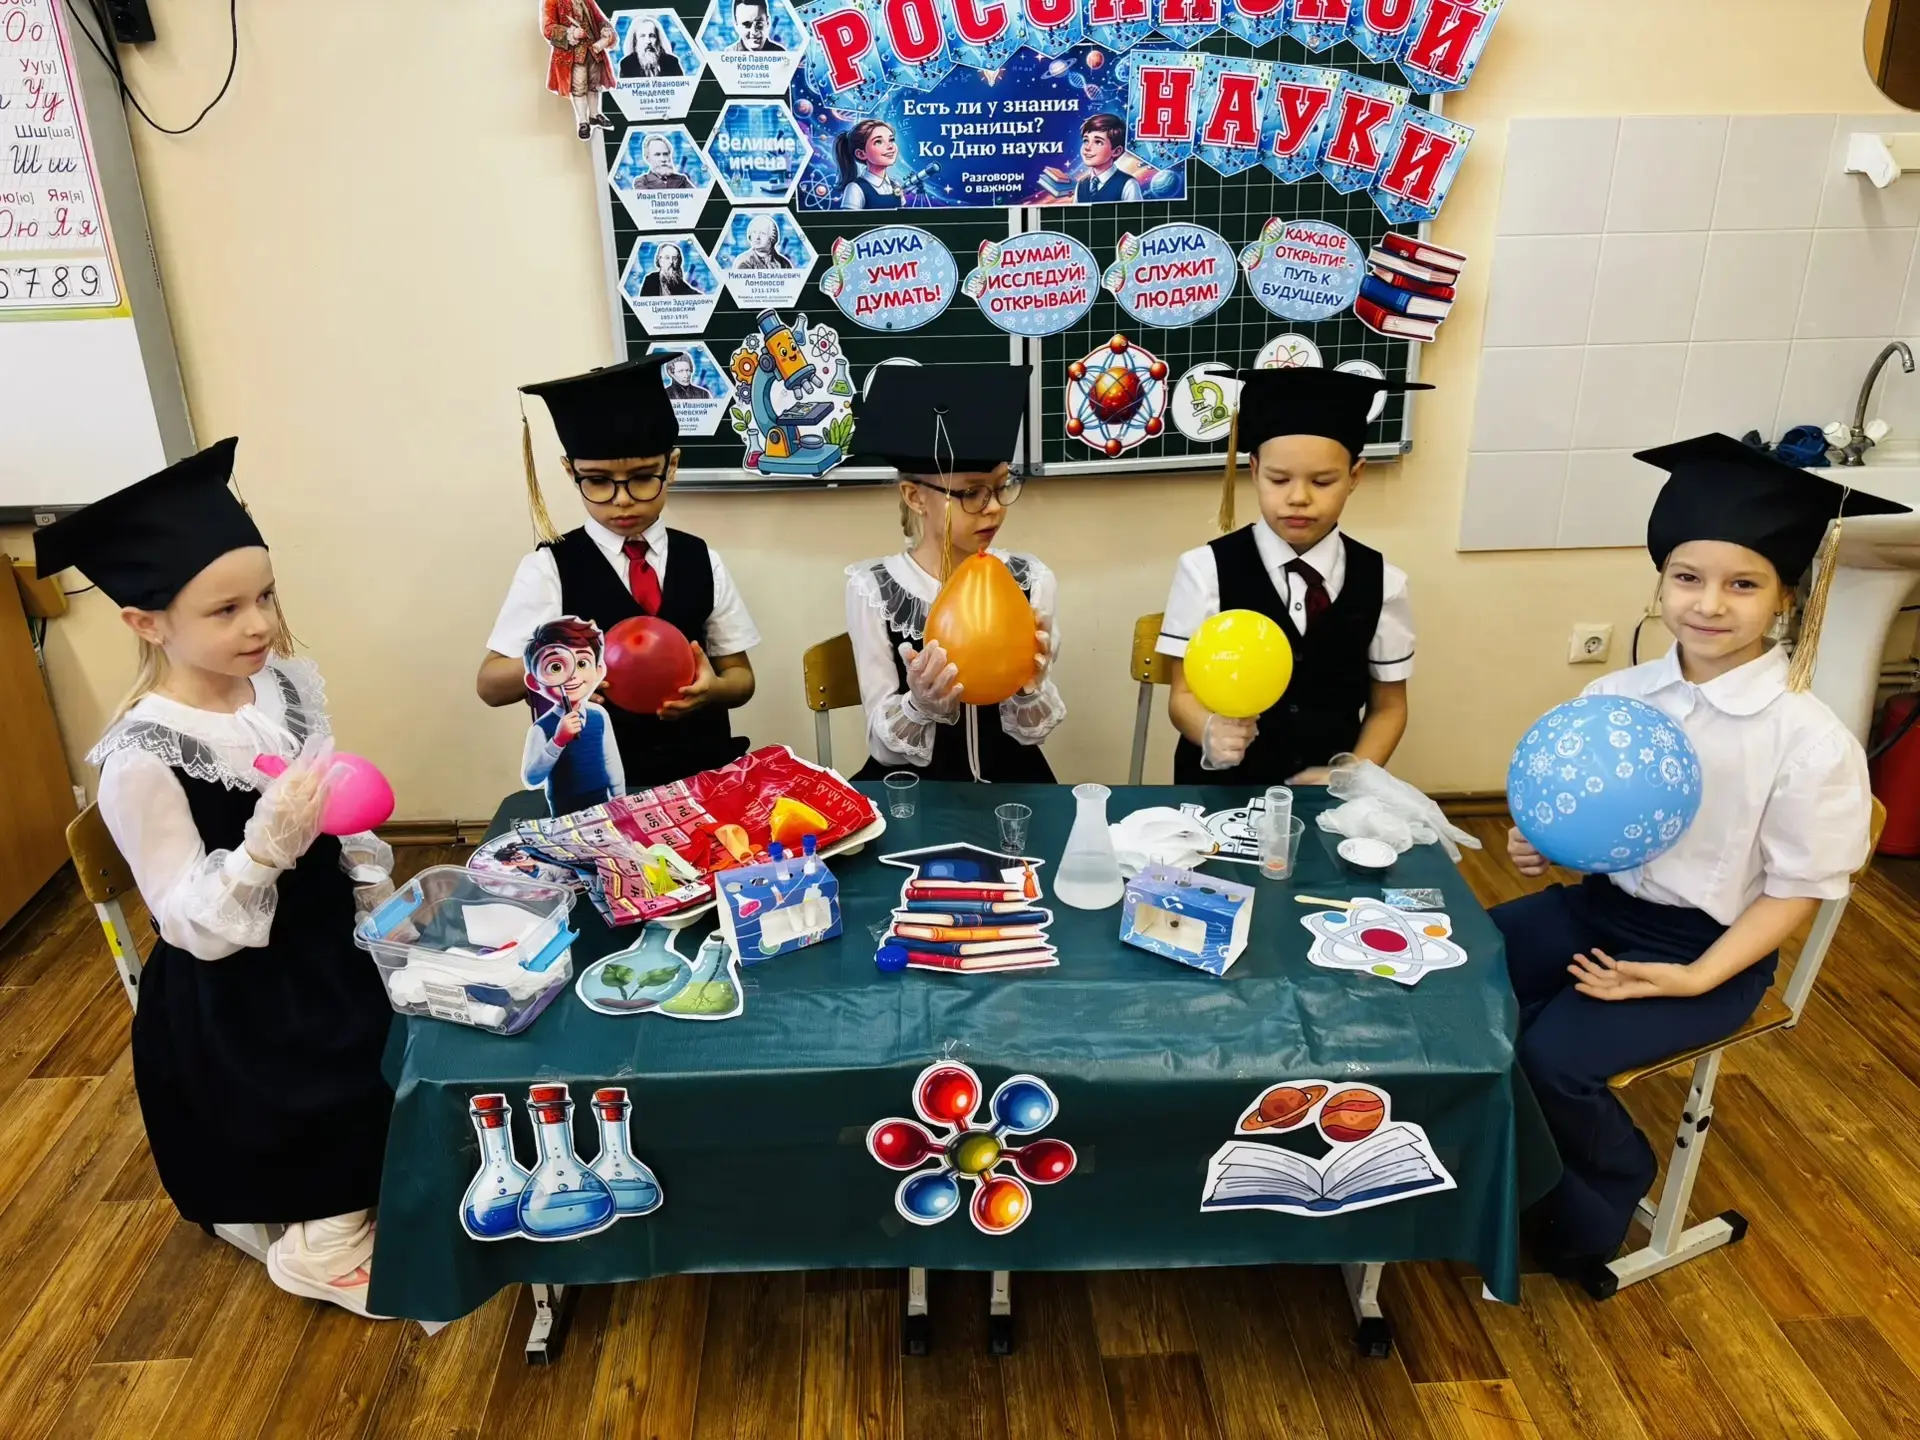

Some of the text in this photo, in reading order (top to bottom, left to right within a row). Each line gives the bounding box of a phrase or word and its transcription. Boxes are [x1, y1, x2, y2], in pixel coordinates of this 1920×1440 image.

[721, 54, 787, 63] Сергей Павлович
[616, 79, 690, 91] Дмитрий Иванович
[632, 88, 675, 98] Менделеев
[903, 99, 950, 116] Есть
[955, 101, 984, 115] ли
[988, 102, 1001, 119] у
[1003, 98, 1079, 115] знания
[940, 117, 1044, 139] границы?
[1137, 66, 1457, 206] НАУКИ
[718, 133, 795, 152] Великие
[918, 139, 1063, 159] Ко Дню науки
[729, 156, 787, 171] имена
[961, 171, 1025, 185] Разговоры
[637, 192, 694, 201] Иван Петрович
[964, 183, 1022, 194] о важном
[651, 200, 679, 208] Павлов
[857, 234, 923, 260] НАУКА
[1142, 233, 1206, 257] НАУКА
[1285, 227, 1347, 250] КАЖДОЕ
[1000, 241, 1071, 268] ДУМАЙ!
[1275, 245, 1347, 269] ОТКРЫТИЕ
[728, 271, 801, 280] Михаил Васильевич
[867, 261, 918, 285] УЧИТ
[987, 265, 1086, 290] ИССЛЕДУЙ!
[1134, 258, 1217, 284] СЛУЖИТ
[1283, 267, 1330, 286] ПУТЬ К
[52, 266, 69, 298] 8
[81, 265, 99, 297] 9
[745, 279, 785, 287] Ломоносов
[633, 299, 714, 308] Константин Эдуардович
[855, 284, 942, 315] ДУМАТЬ!
[990, 289, 1087, 313] ОТКРЫВАЙ!
[1134, 283, 1219, 310] ЛЮДЯМ!
[1261, 282, 1345, 307] БУДУЩЕМУ
[652, 306, 696, 314] Циолковский
[682, 401, 718, 409] Иванович
[645, 812, 660, 829] Sm
[678, 804, 691, 818] Pu
